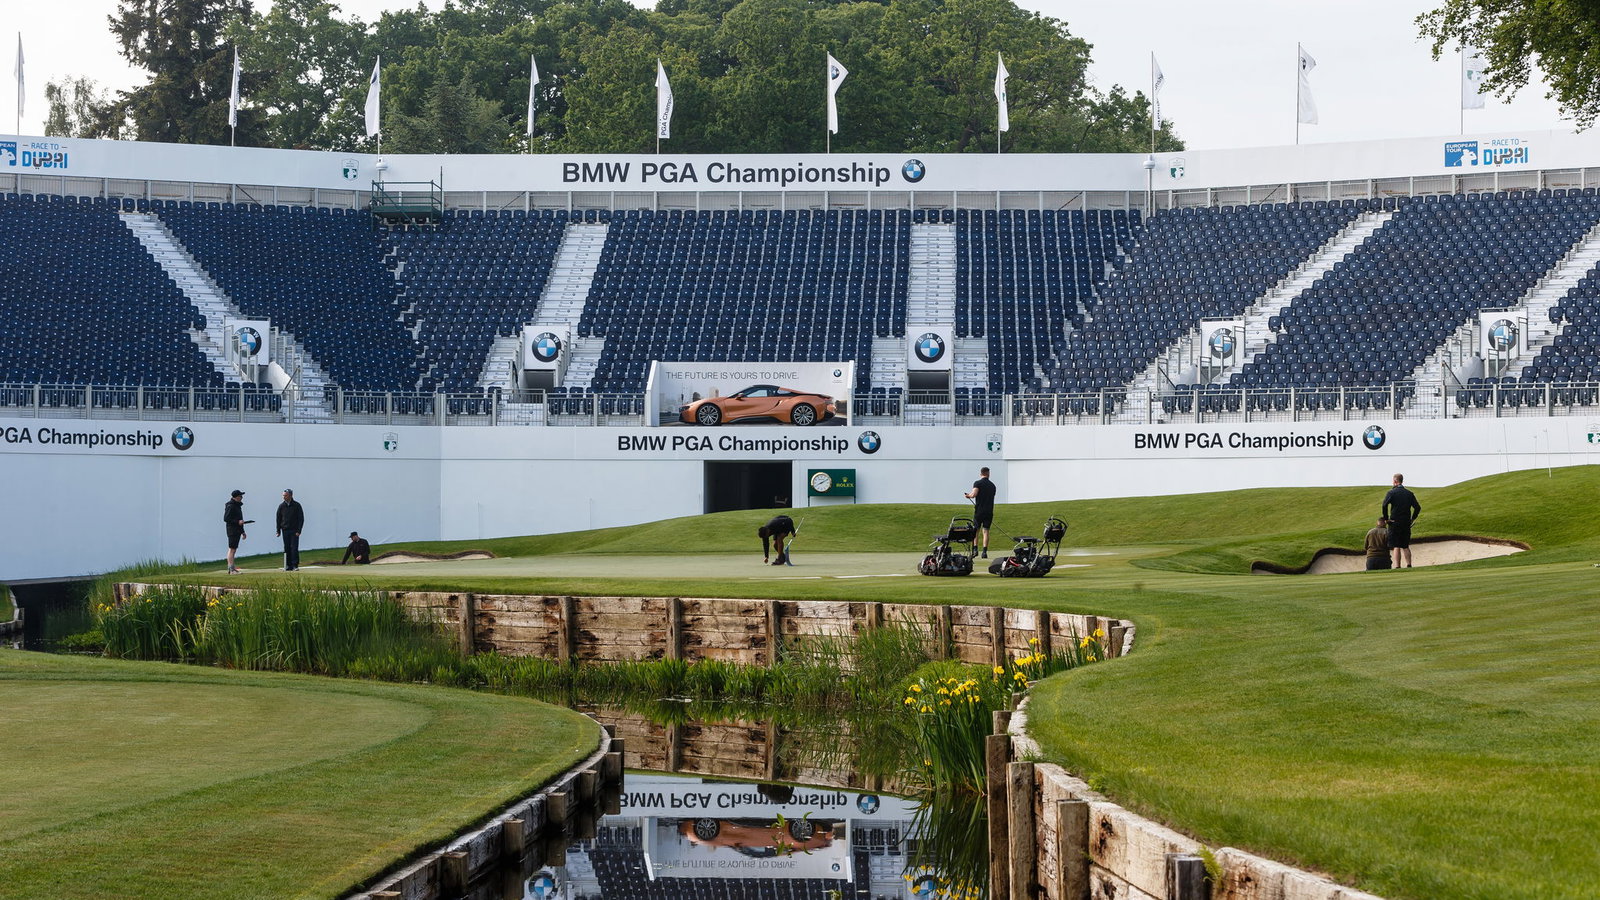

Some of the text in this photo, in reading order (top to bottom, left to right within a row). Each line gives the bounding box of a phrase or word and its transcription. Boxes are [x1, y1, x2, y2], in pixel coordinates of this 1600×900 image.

[31, 142, 48, 150] RACE
[22, 151, 68, 169] DUBAI
[1483, 147, 1529, 166] DUBAI
[562, 162, 891, 187] BMW PGA Championship
[685, 371, 719, 379] FUTURE
[720, 371, 728, 379] IS
[730, 371, 758, 379] YOURS
[760, 371, 771, 379] TO
[37, 427, 164, 449] Championship
[617, 435, 849, 454] BMW PGA Championship
[1134, 431, 1354, 451] BMW PGA Championship
